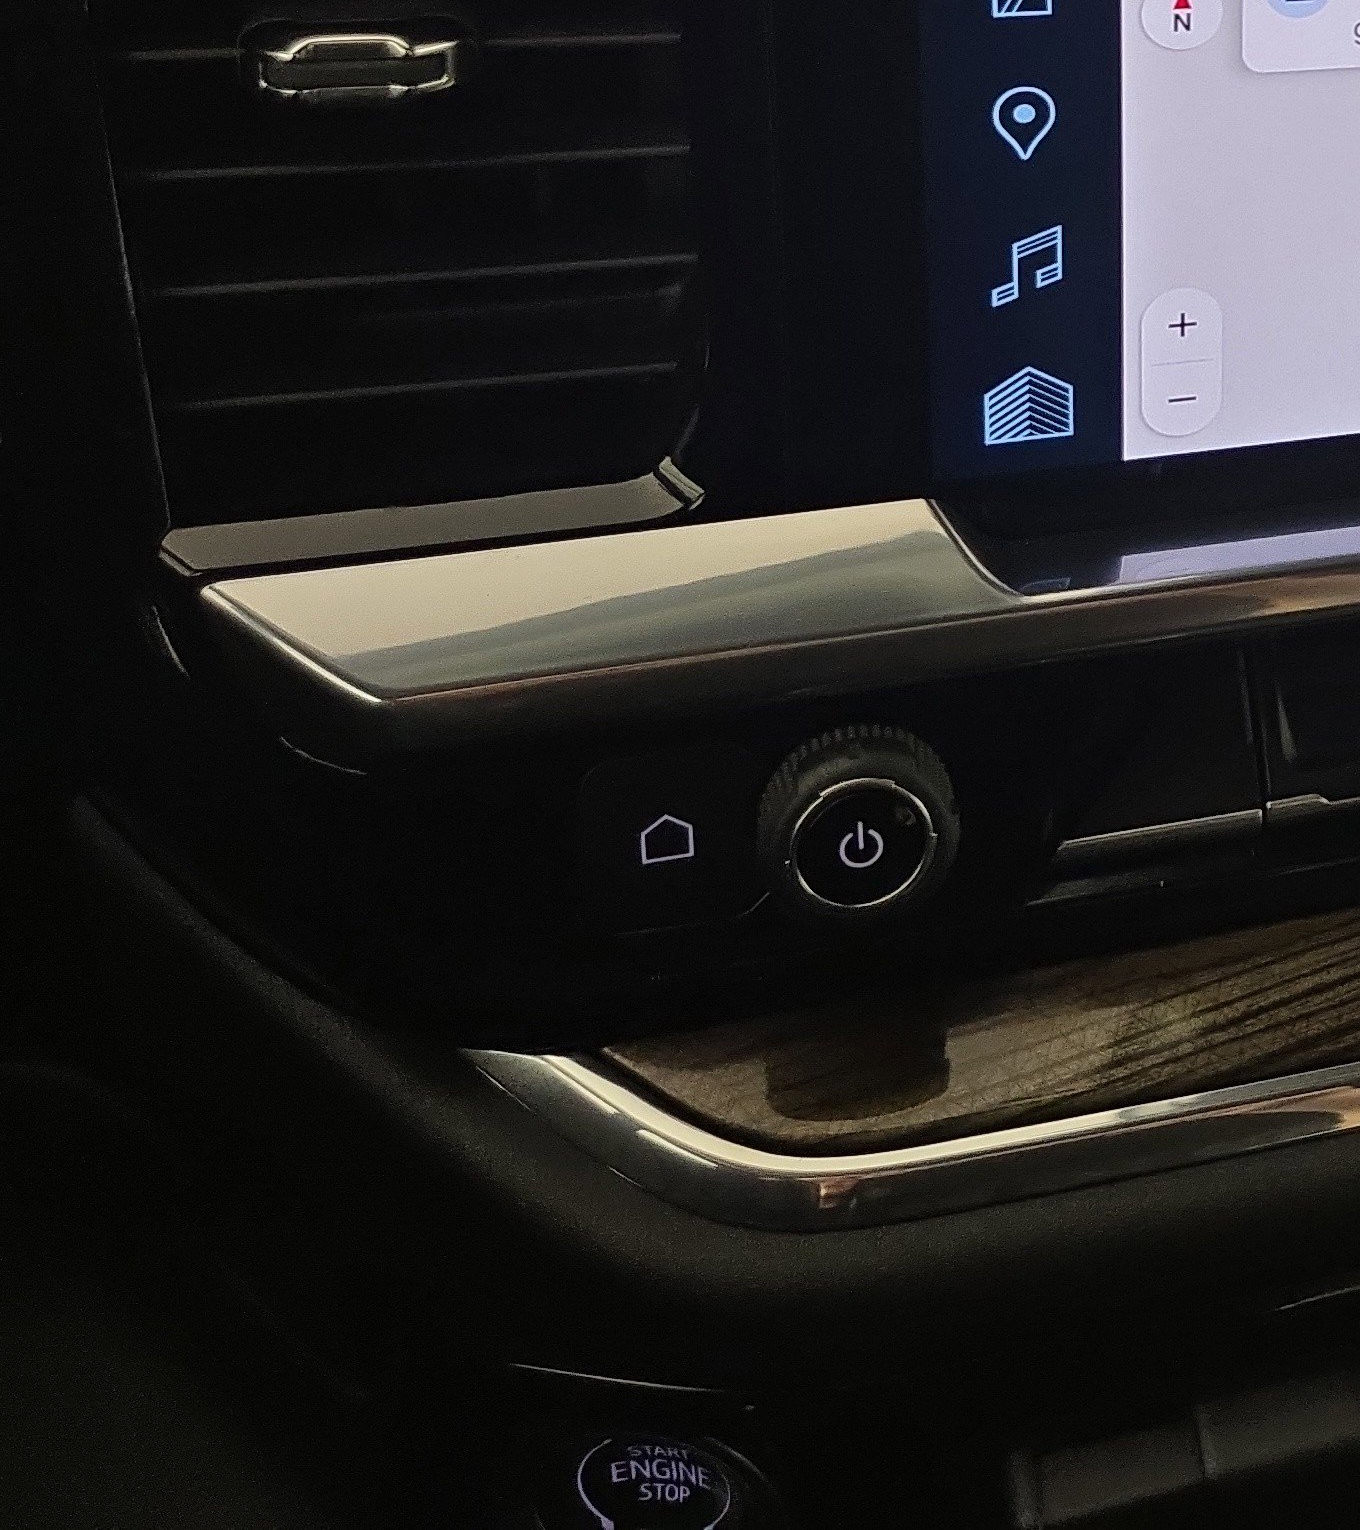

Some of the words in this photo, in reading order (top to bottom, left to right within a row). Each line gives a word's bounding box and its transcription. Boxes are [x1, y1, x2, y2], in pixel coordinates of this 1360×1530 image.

[1173, 13, 1191, 33] N
[627, 1445, 689, 1460] START
[610, 1460, 711, 1488] ENGINE
[637, 1483, 690, 1502] STOP
